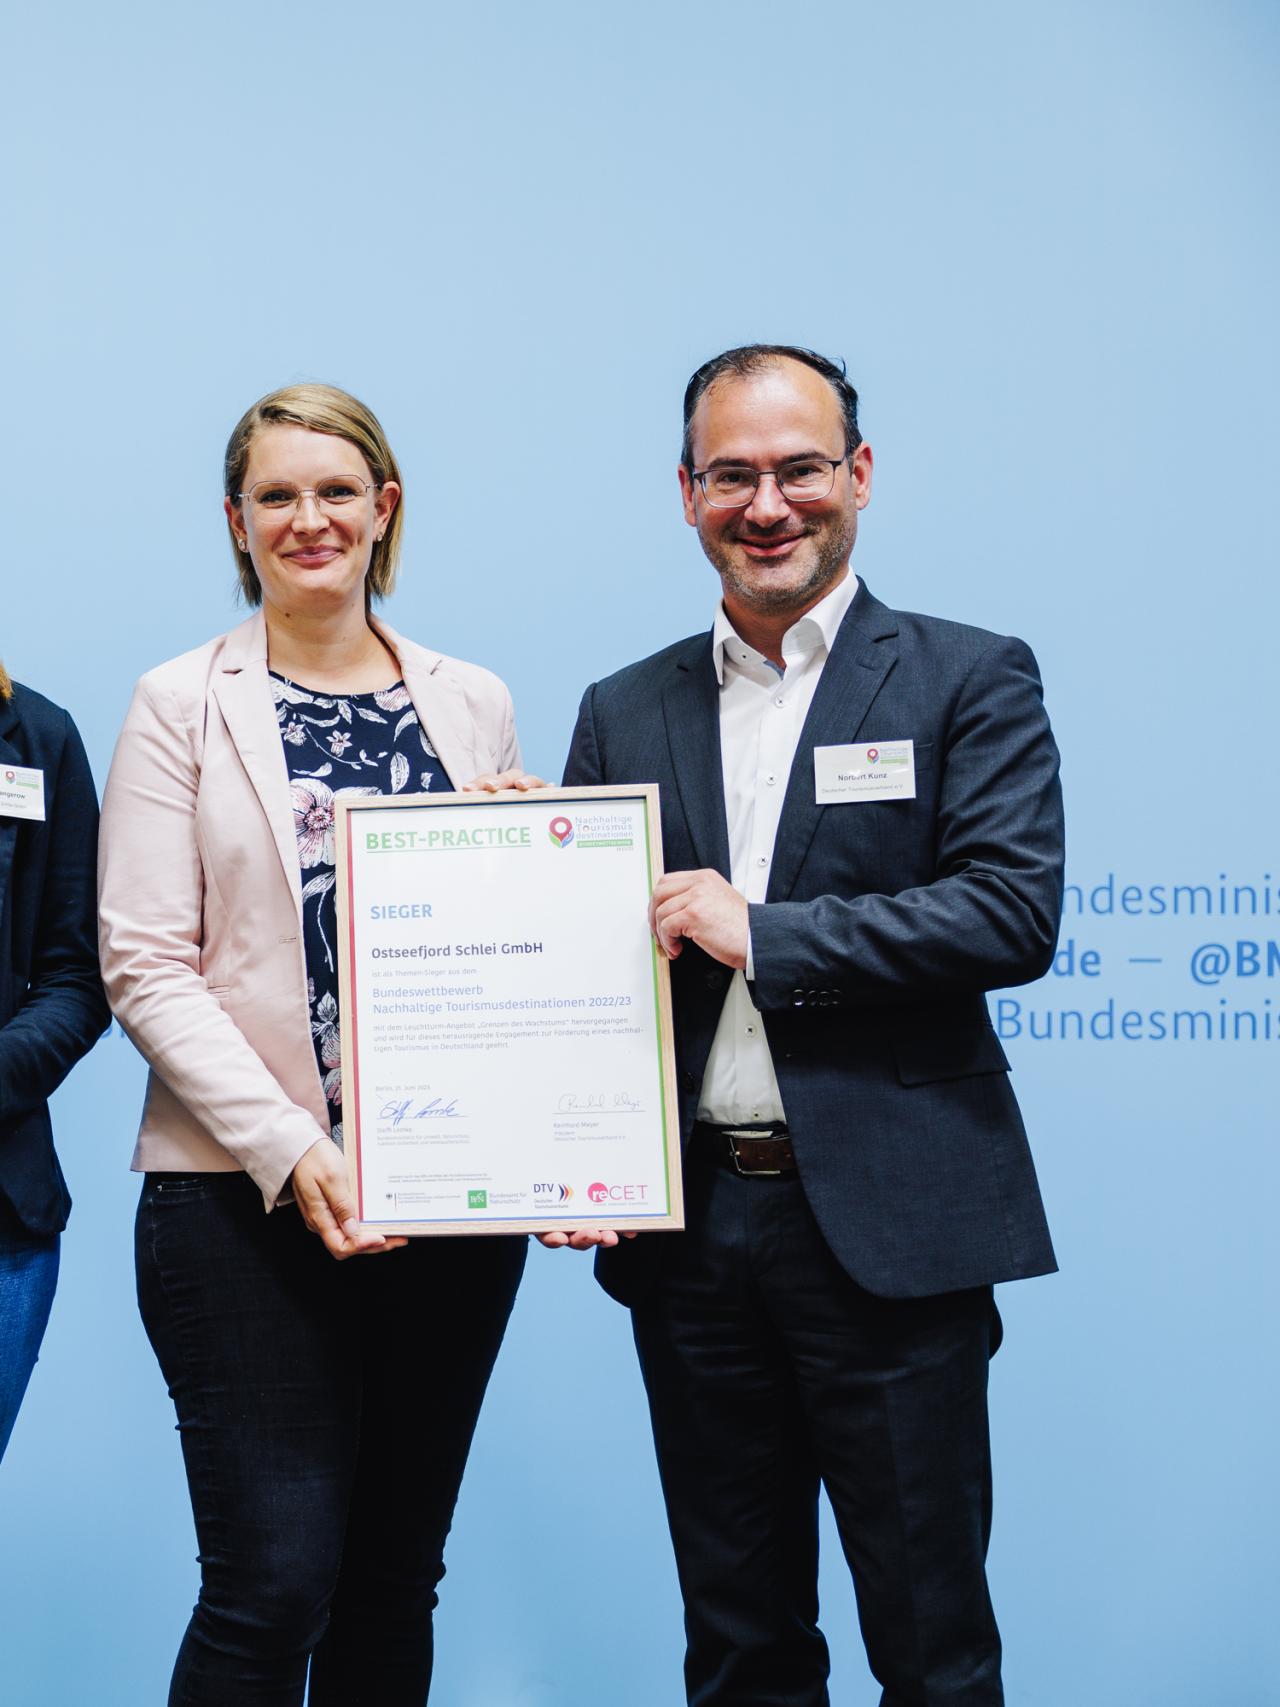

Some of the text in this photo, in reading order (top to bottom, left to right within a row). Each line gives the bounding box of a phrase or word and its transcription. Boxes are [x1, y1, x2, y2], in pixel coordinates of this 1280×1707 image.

[575, 816, 632, 825] Nachhaltige
[576, 824, 632, 832] Tourismus
[366, 826, 531, 850] BEST-PRACTICE
[370, 904, 433, 920] SIEGER
[371, 941, 544, 960] Ostseefjord Schlei GmbH
[462, 967, 477, 975] dem
[372, 985, 484, 998] Bundeswettbewerb
[373, 996, 632, 1015] Nachhaltige Tourismusdestinationen 2022/23
[533, 1183, 554, 1193] DTV
